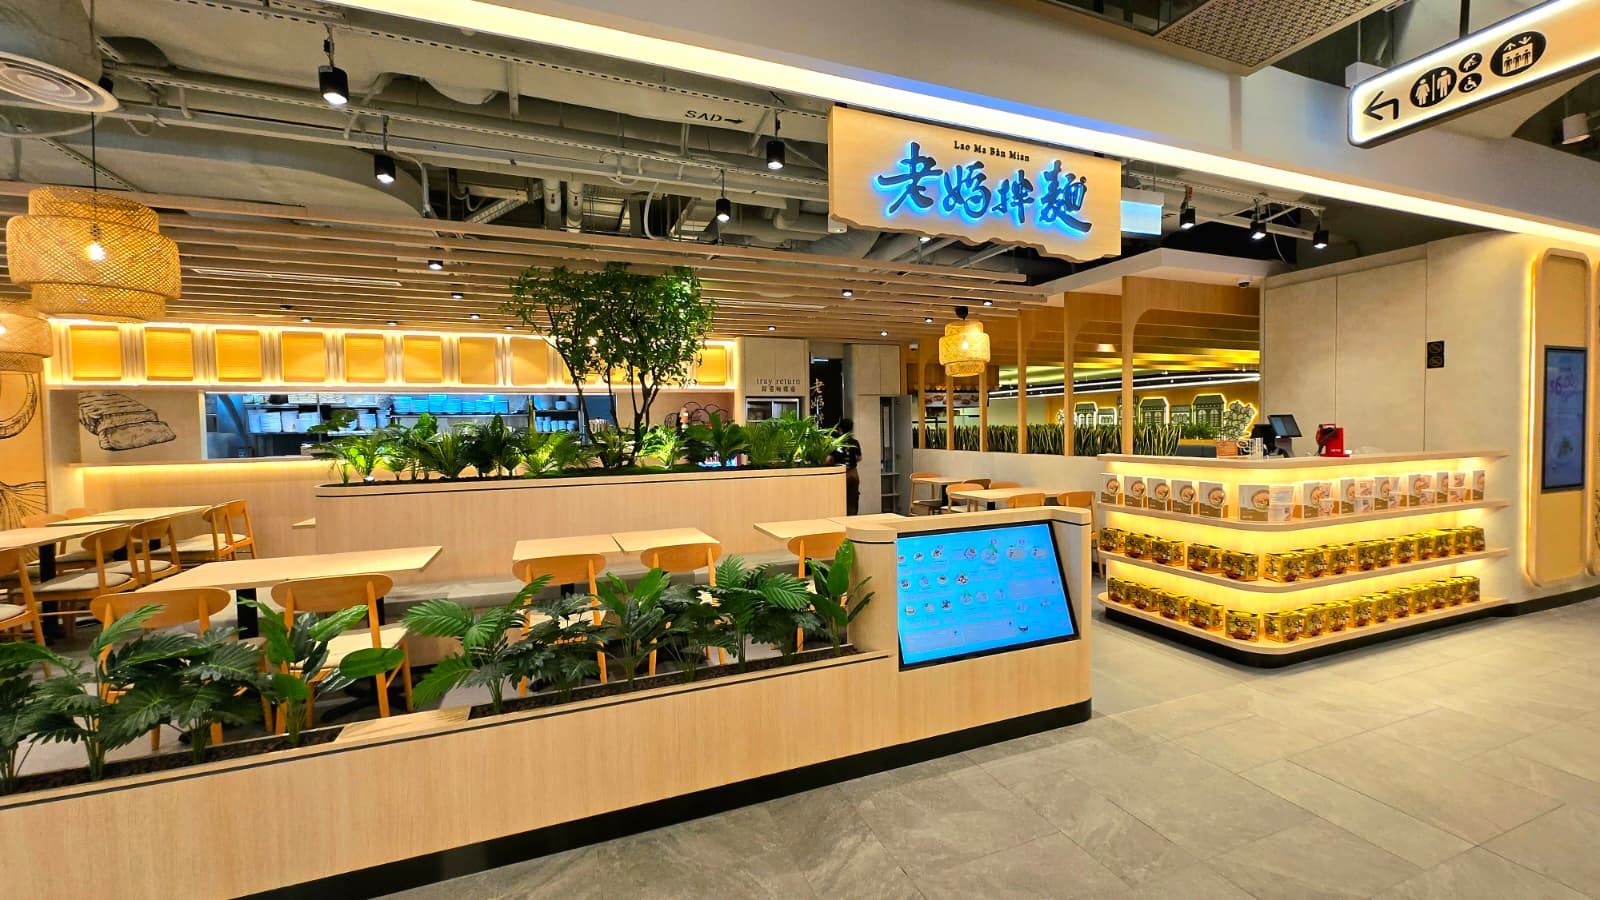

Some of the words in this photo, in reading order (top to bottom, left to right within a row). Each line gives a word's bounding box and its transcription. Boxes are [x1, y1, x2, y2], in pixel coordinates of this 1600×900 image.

[685, 110, 722, 122] SAD
[954, 141, 970, 150] Lao
[974, 144, 986, 153] Ma
[1009, 151, 1029, 161] Mian
[878, 142, 1092, 232] 老媽拌麵
